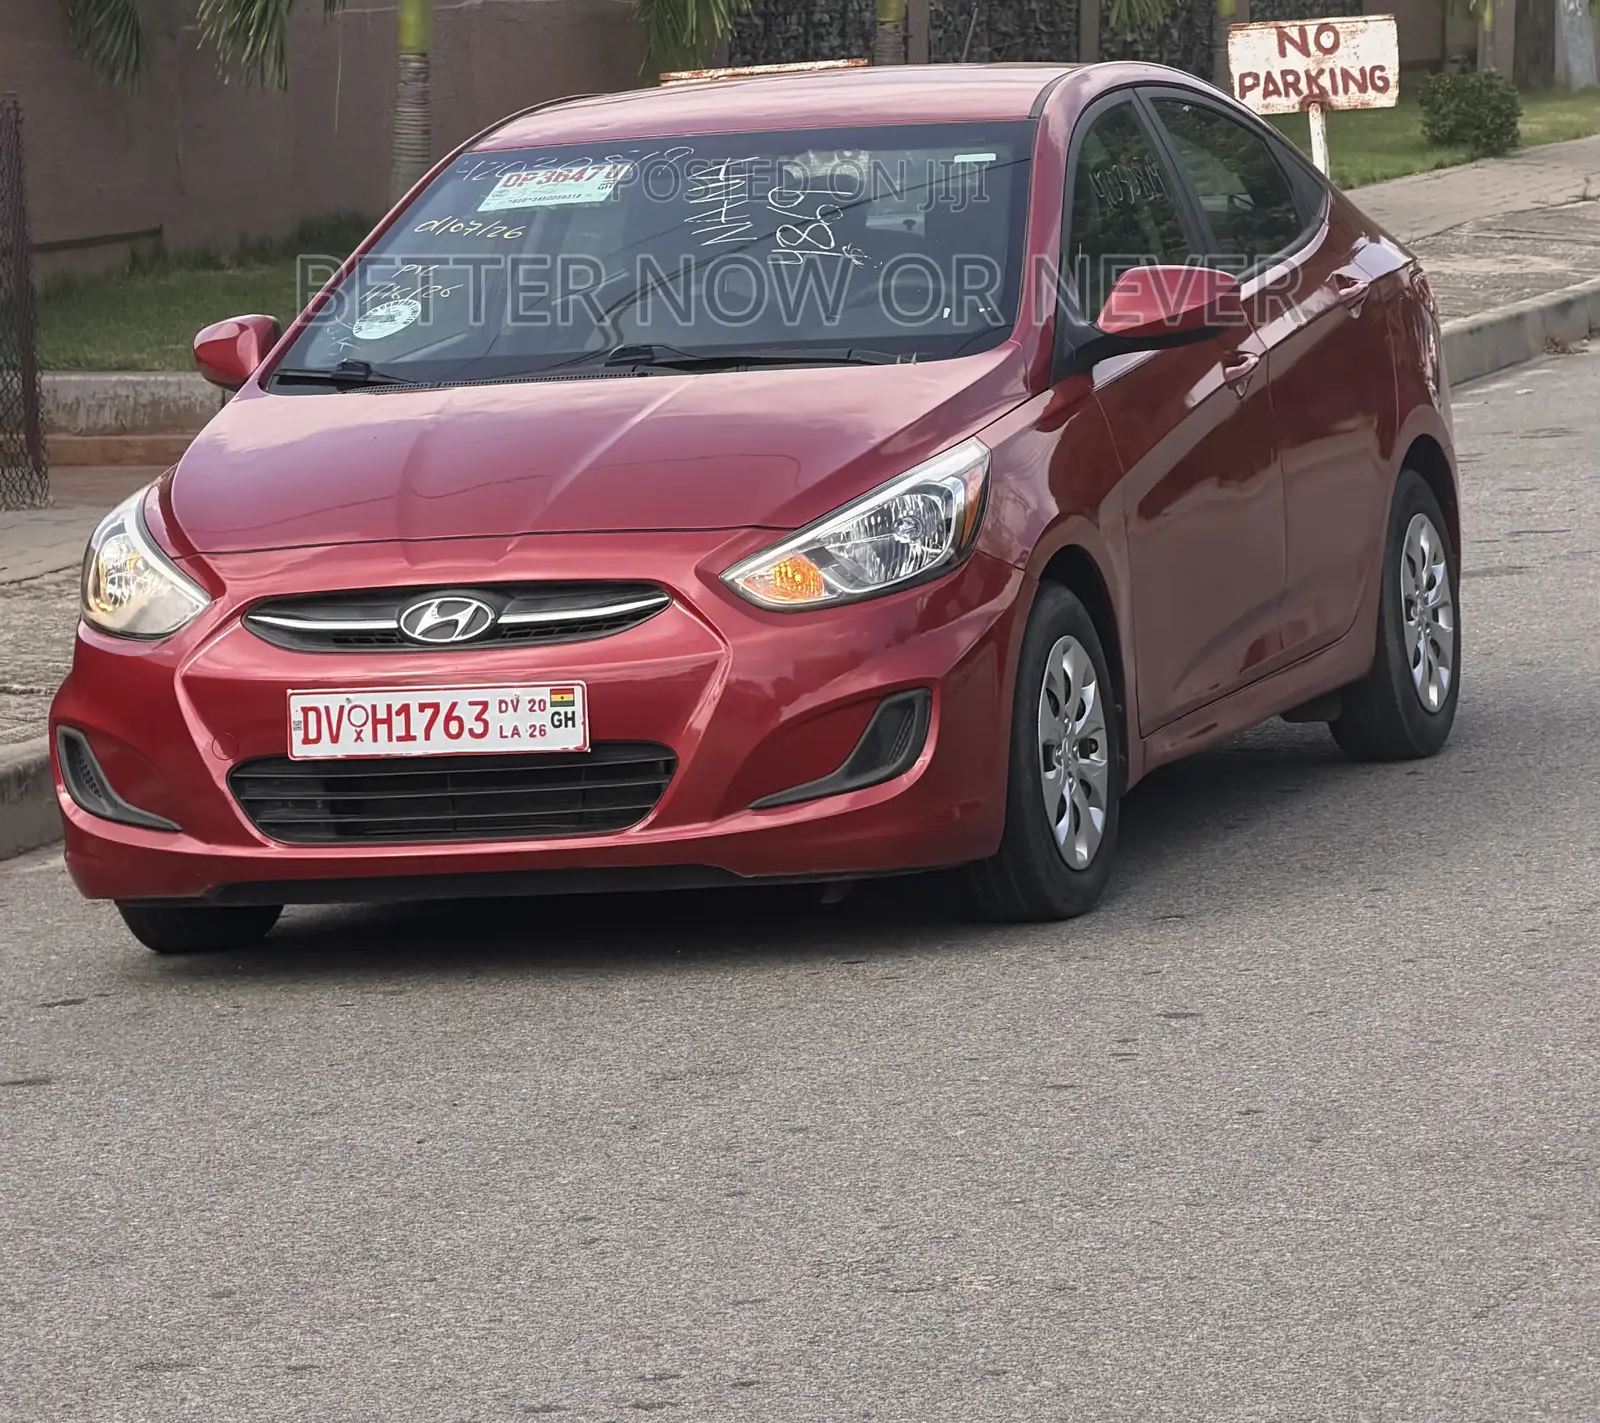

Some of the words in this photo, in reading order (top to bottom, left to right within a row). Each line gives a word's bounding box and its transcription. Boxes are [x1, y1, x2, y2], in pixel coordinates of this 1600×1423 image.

[1276, 24, 1341, 59] NO
[1238, 64, 1391, 100] PARKING
[498, 698, 520, 714] DV
[527, 698, 547, 713] 20
[550, 710, 576, 729] GH
[300, 704, 345, 745] DV
[371, 700, 490, 743] H1763
[499, 724, 522, 739] LA
[527, 723, 547, 738] 26
